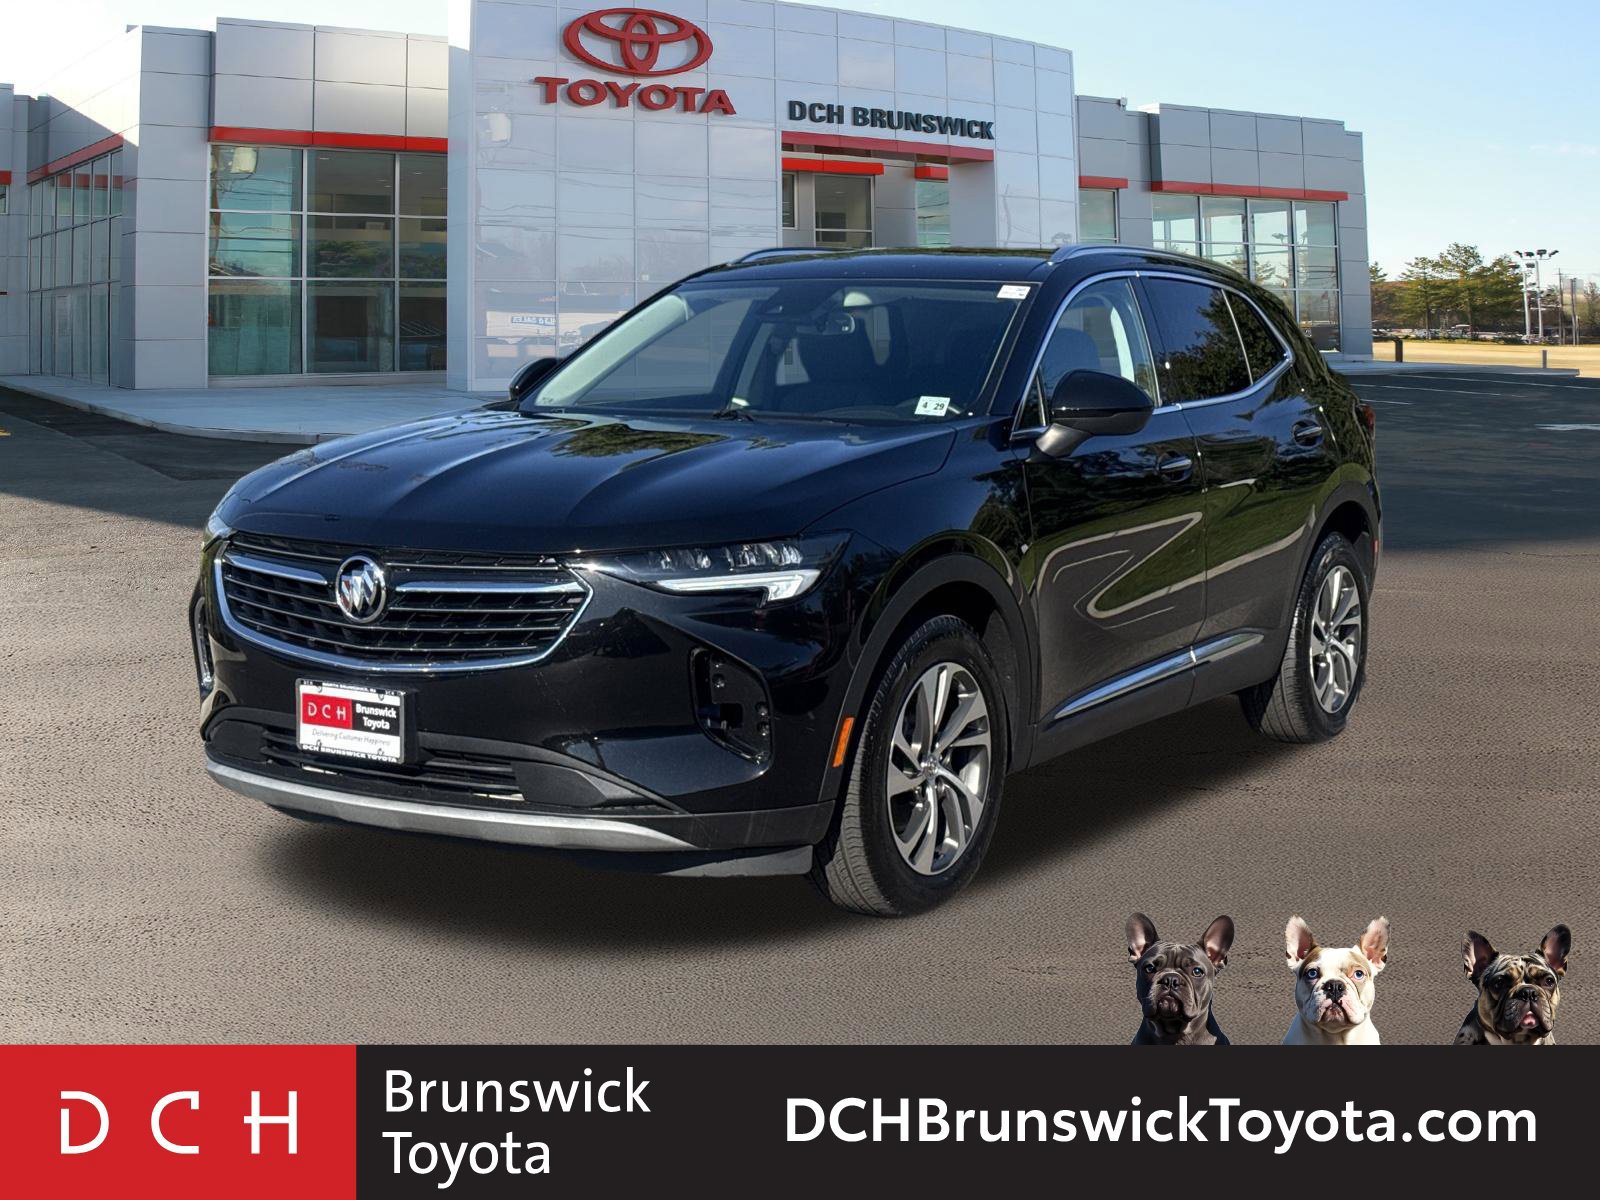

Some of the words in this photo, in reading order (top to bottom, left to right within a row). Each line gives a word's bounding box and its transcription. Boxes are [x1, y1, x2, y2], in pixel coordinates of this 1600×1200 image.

[534, 76, 737, 115] TOYOTA
[788, 100, 845, 124] DCH
[852, 106, 995, 140] BRUNSWICK
[933, 402, 945, 411] 29
[355, 703, 397, 719] Brunswick
[363, 716, 390, 731] Toyota
[302, 744, 320, 752] DCH
[320, 747, 366, 759] BRUNSWICK
[367, 754, 397, 763] TOYOTA
